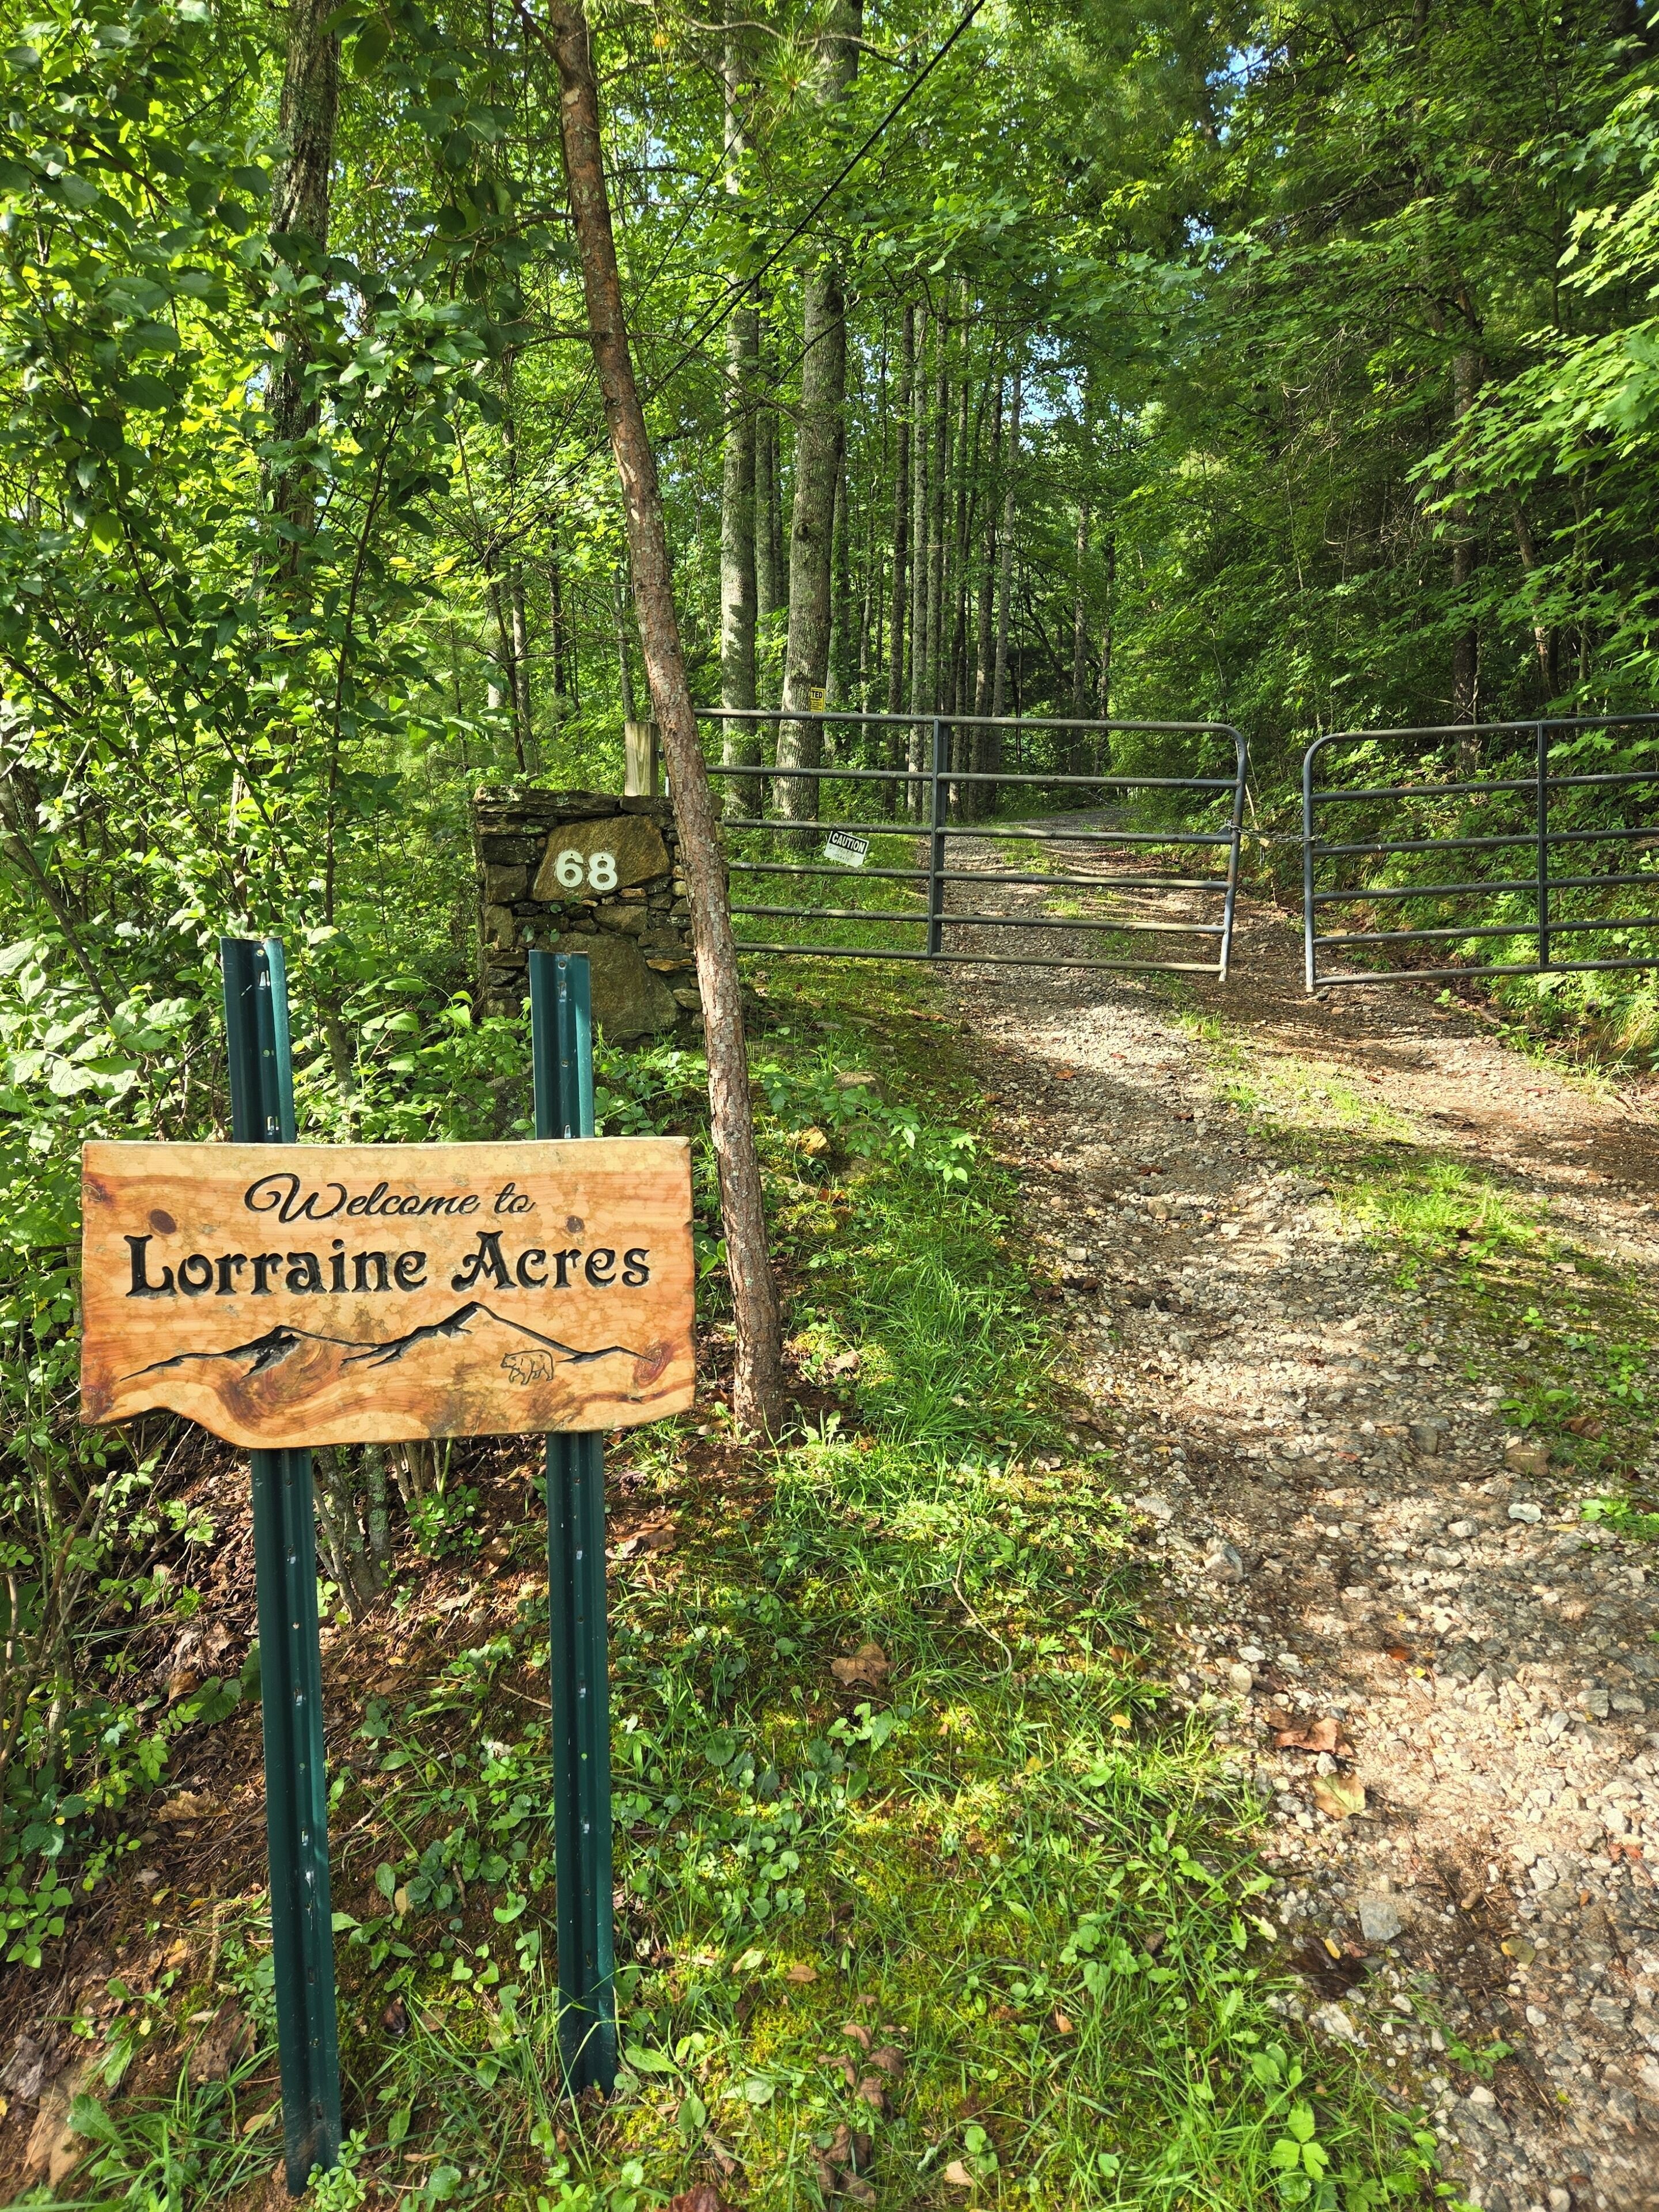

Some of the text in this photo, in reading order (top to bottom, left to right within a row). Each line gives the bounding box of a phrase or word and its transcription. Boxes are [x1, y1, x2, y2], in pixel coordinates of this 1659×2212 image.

[832, 832, 865, 853] CAUTION
[556, 850, 618, 891] 68
[244, 1173, 536, 1224] Welcome to
[124, 1230, 650, 1297] Lorraine Acres
